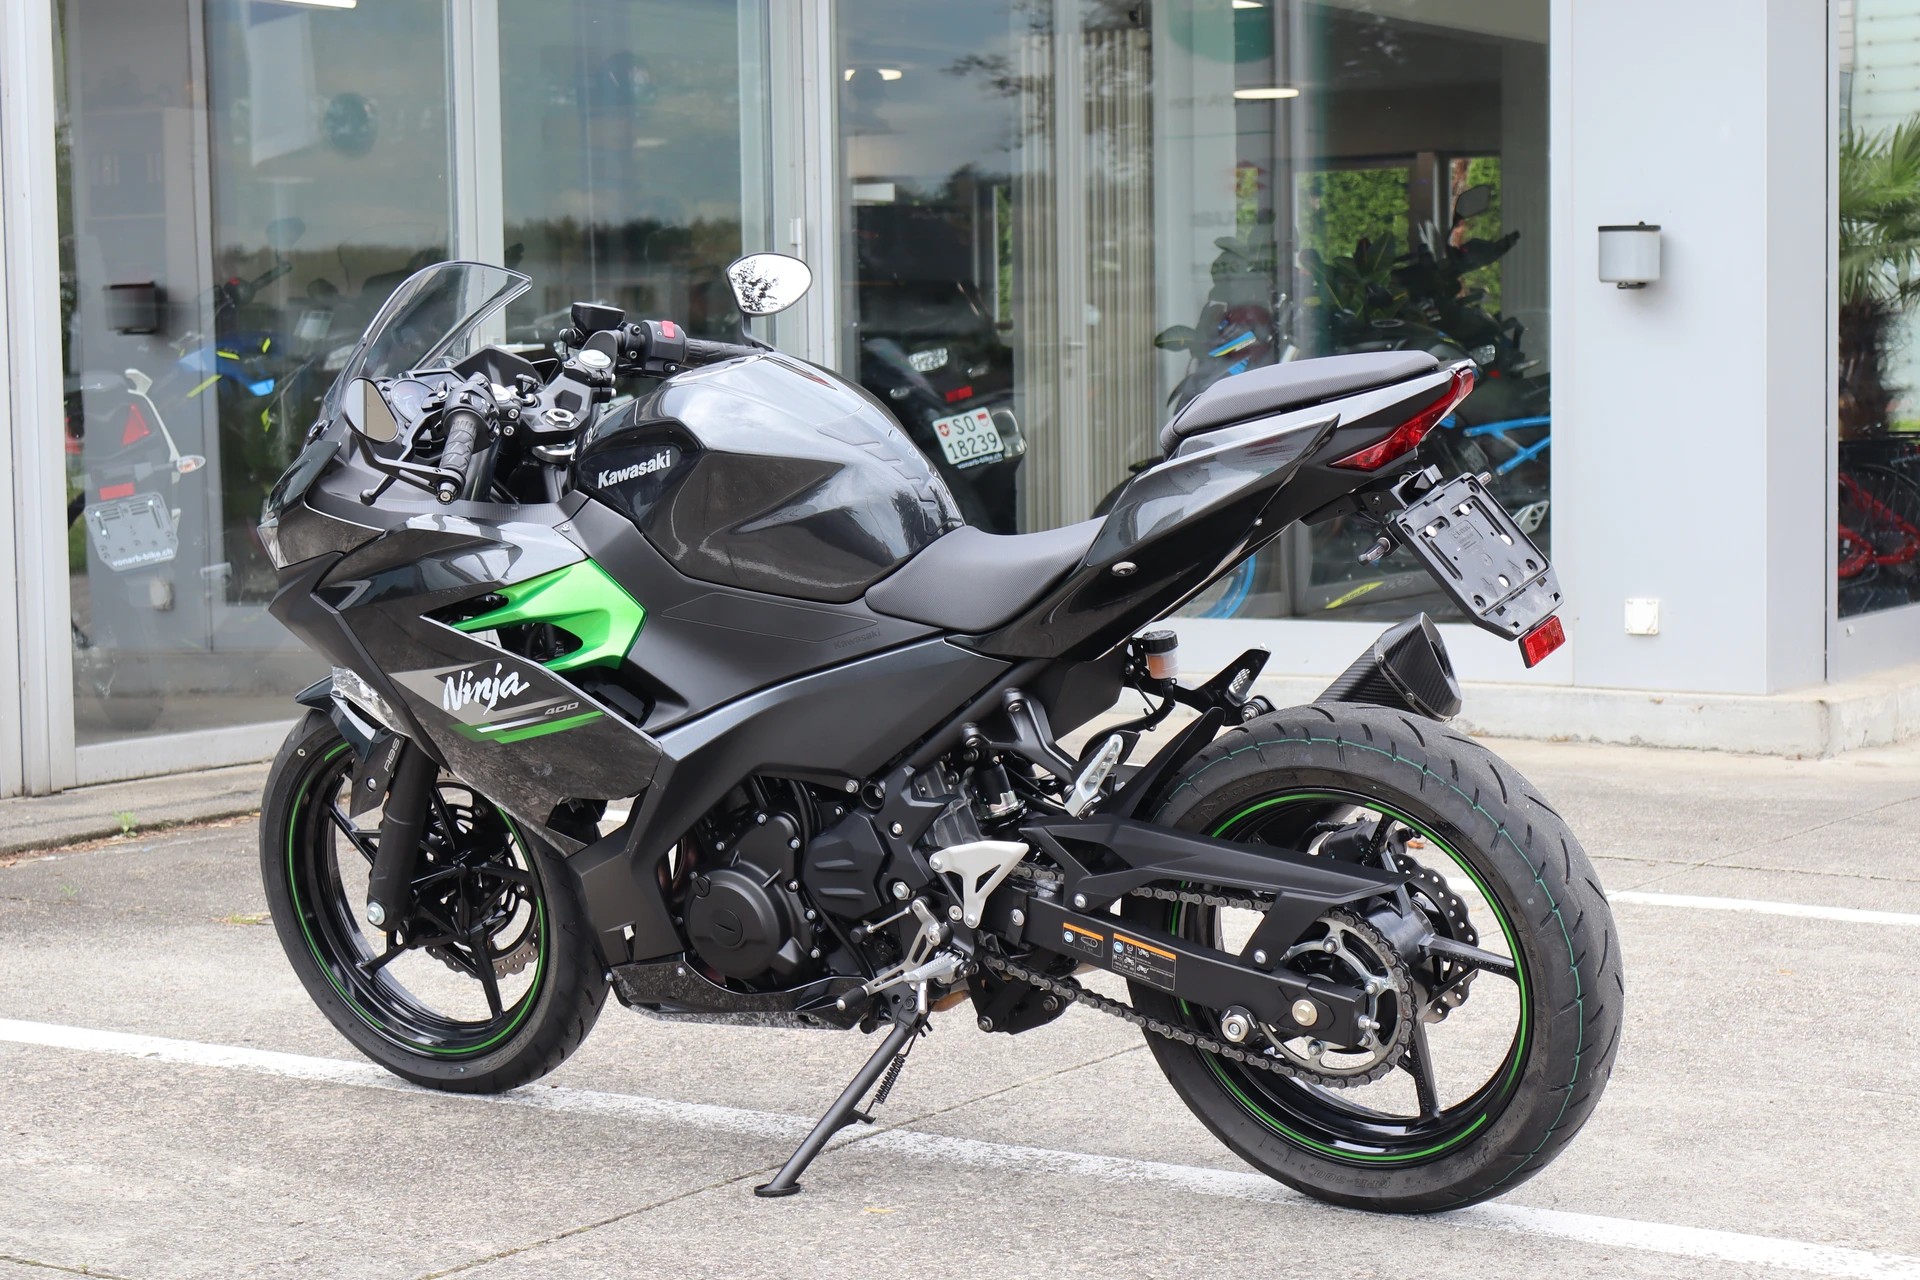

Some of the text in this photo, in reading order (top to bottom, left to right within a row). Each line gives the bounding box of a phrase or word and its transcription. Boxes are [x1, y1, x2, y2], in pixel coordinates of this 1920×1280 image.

[952, 415, 976, 435] SO
[947, 432, 998, 460] 18239
[597, 450, 671, 489] Kawasaki
[833, 628, 881, 650] Kawasaki
[443, 662, 530, 715] Ninja
[544, 701, 580, 716] 400
[384, 737, 400, 772] ABS
